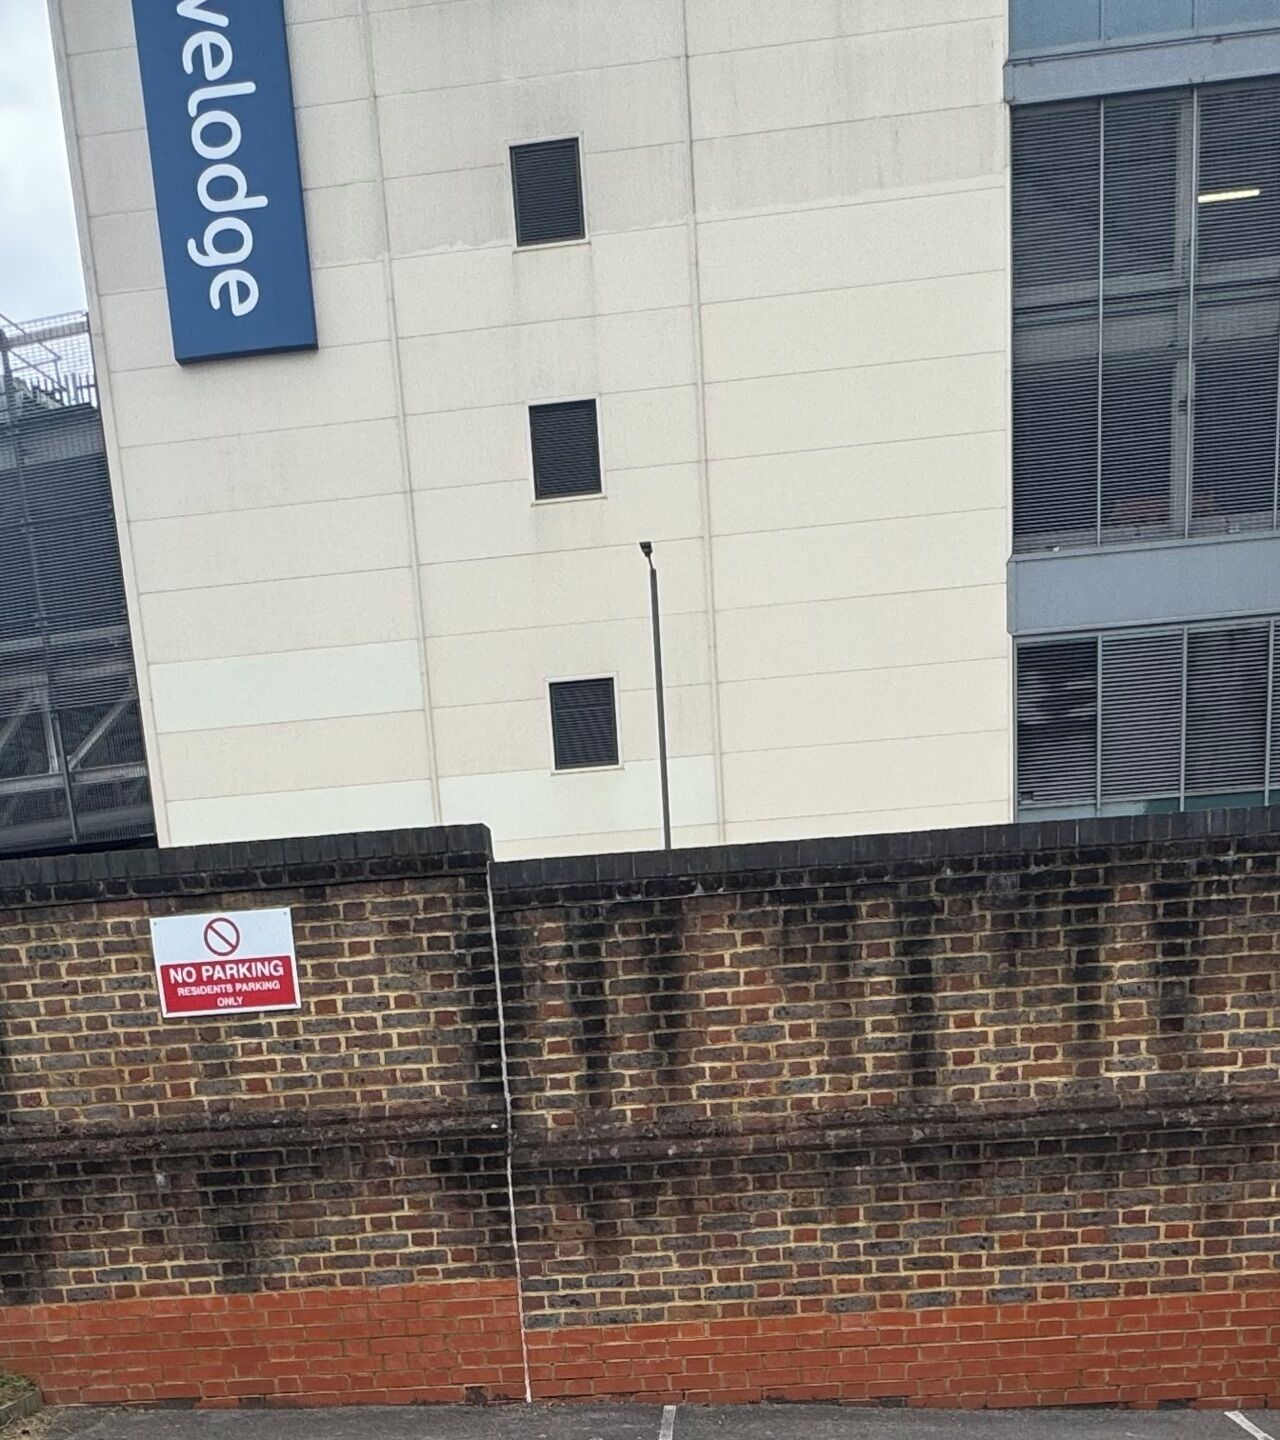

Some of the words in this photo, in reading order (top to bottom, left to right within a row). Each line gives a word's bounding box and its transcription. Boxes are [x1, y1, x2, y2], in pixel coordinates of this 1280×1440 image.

[169, 966, 196, 984] NO
[201, 960, 284, 981] PARKING
[177, 984, 233, 996] RESIDENTS
[235, 980, 280, 992] PARKING
[217, 996, 244, 1007] ONLY
